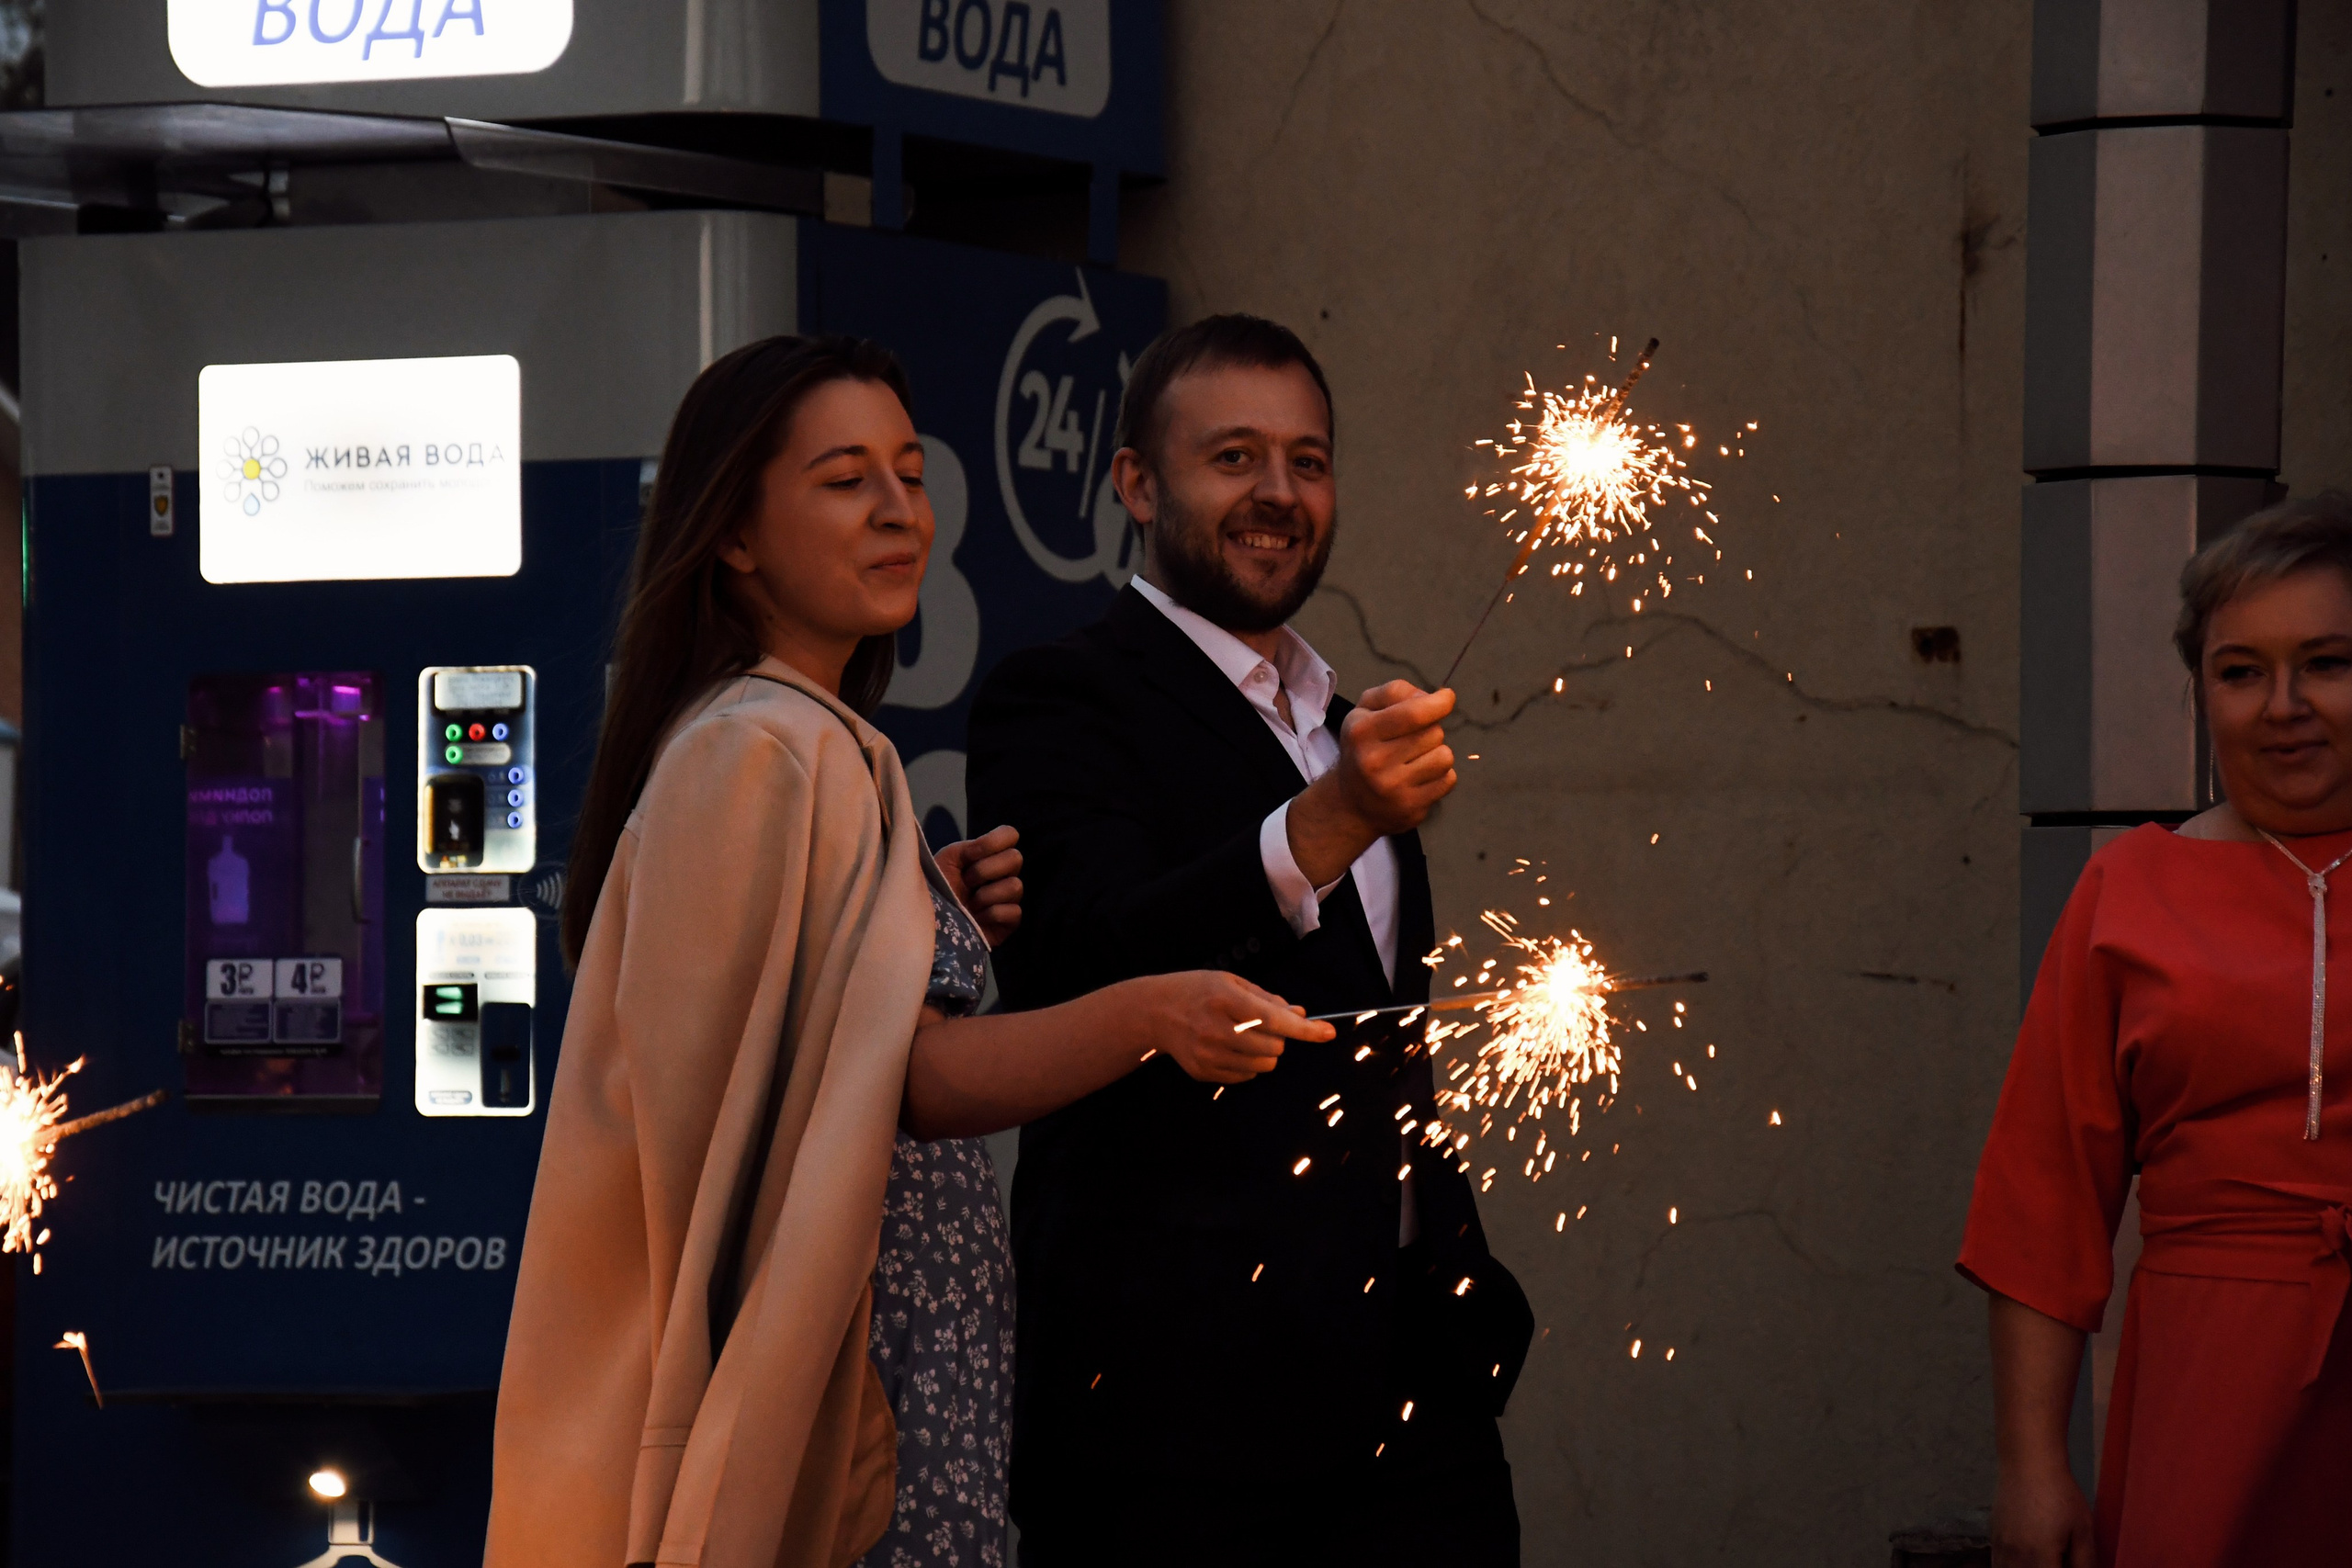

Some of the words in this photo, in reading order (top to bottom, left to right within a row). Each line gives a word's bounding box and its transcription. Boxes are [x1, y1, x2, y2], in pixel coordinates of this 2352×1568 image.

[252, 0, 484, 61] ВОДА
[919, 0, 1067, 98] ВОДА
[305, 445, 411, 469] ЖИВАЯ
[424, 442, 505, 468] ВОДА
[154, 1181, 290, 1213] ЧИСТАЯ
[300, 1181, 402, 1221] ВОДА
[151, 1235, 348, 1269] ИСТОЧНИК
[353, 1236, 508, 1277] ЗДОРОВ
